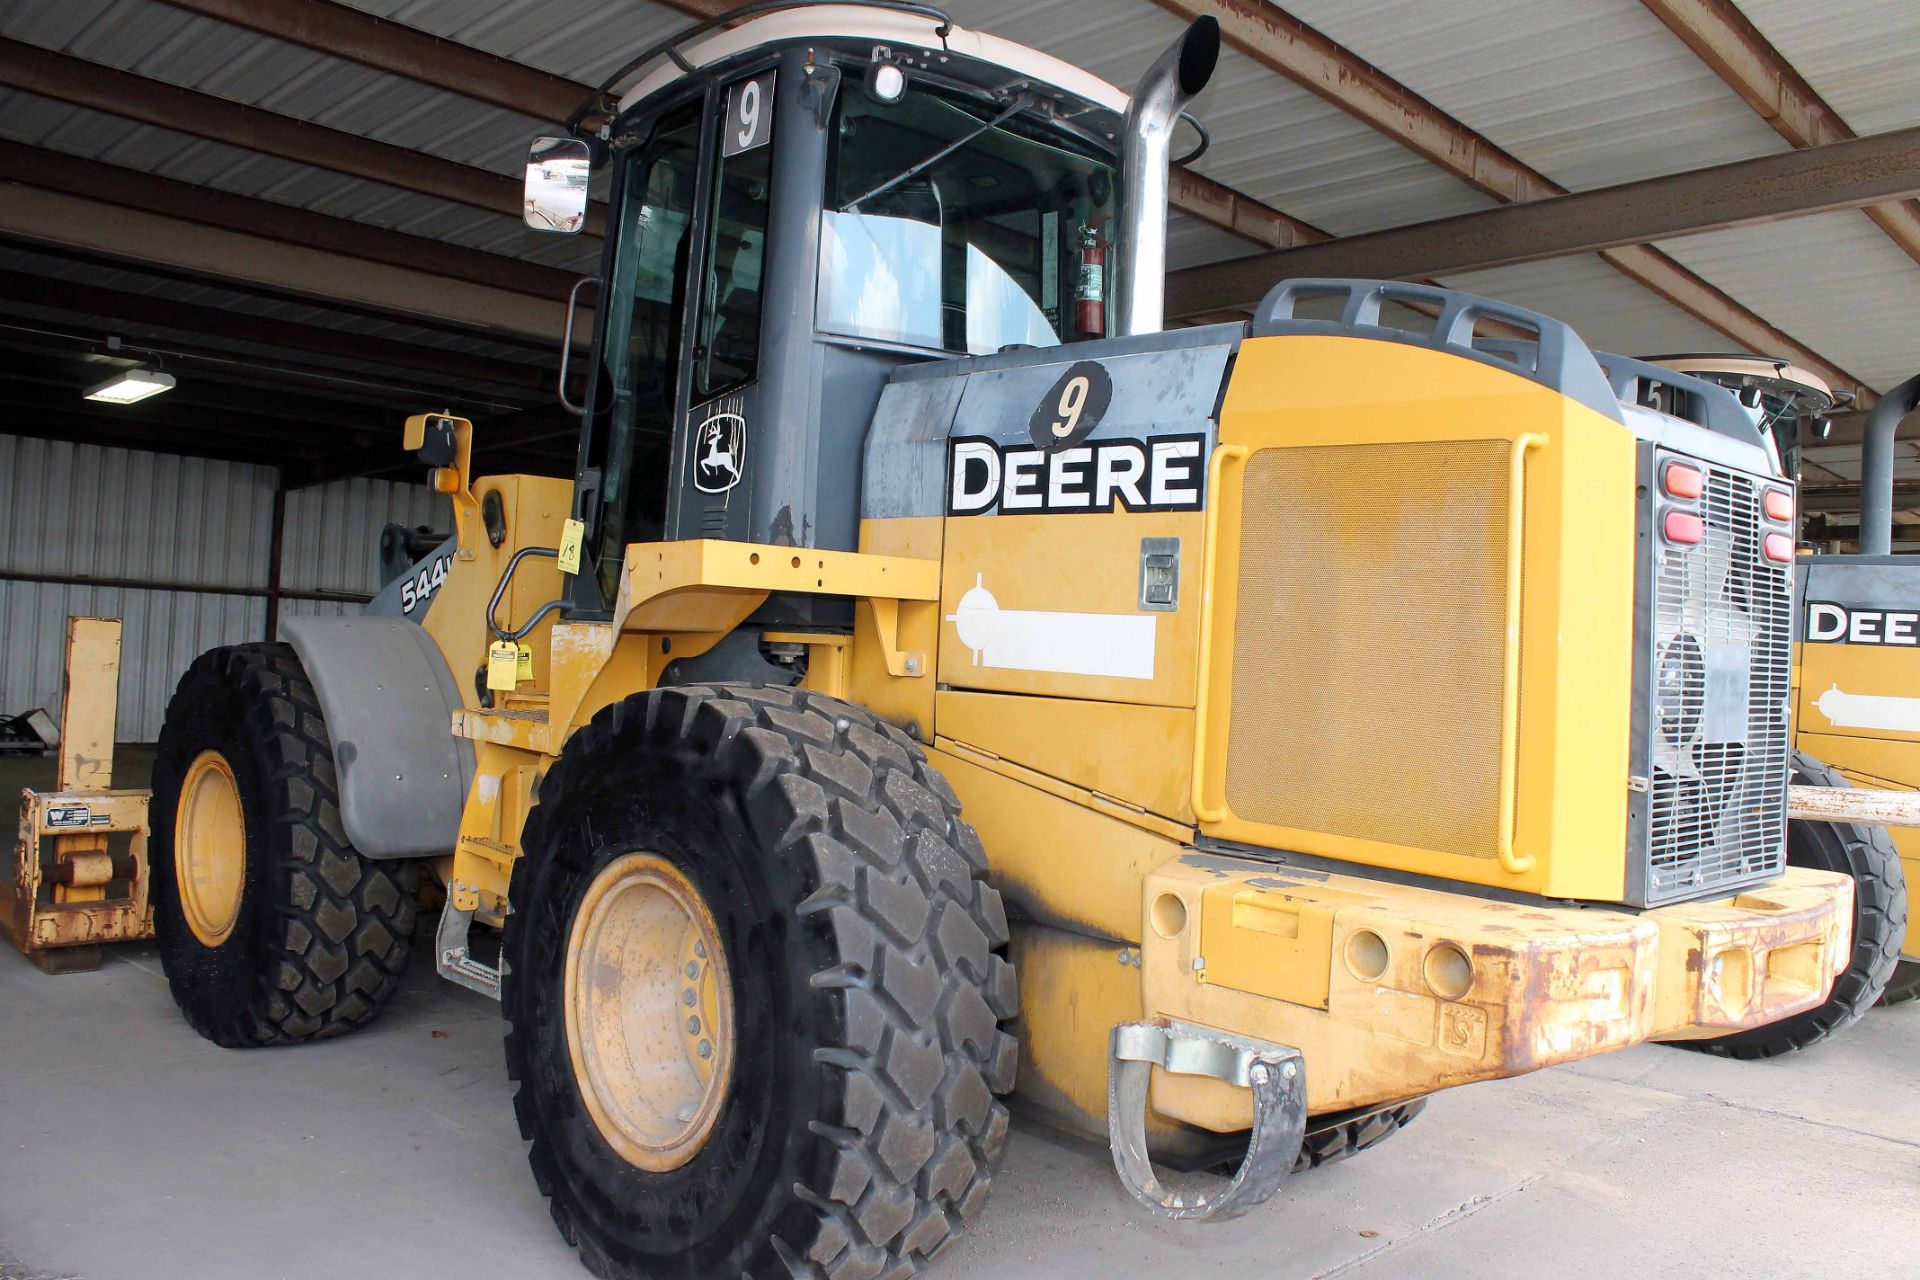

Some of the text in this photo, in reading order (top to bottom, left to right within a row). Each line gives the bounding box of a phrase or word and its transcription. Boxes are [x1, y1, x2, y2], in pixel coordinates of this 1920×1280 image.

[738, 80, 760, 147] 9
[1051, 376, 1090, 438] 9
[1648, 380, 1662, 411] 5
[951, 440, 1200, 511] DEERE
[562, 543, 575, 560] 18
